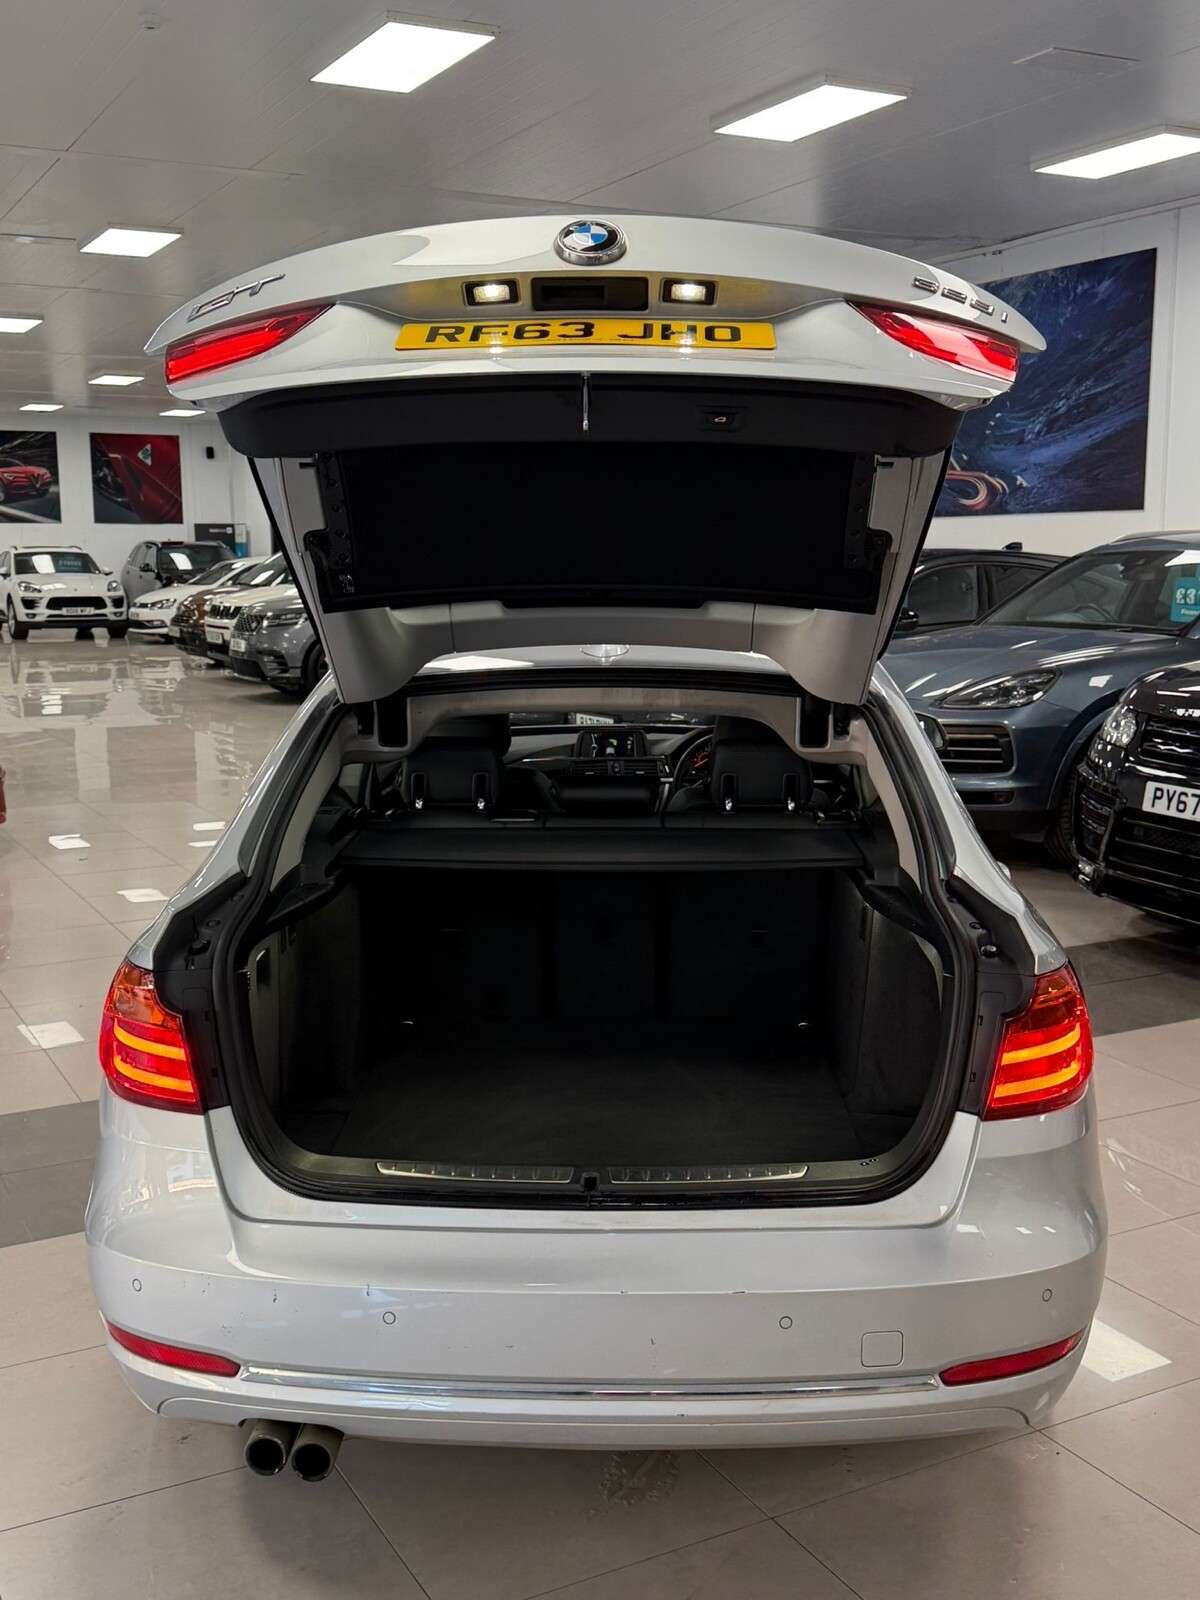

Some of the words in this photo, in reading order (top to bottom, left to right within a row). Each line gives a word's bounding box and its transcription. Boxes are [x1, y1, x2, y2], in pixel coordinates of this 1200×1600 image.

[425, 322, 595, 343] RF63
[618, 323, 742, 343] JHO
[1151, 786, 1200, 816] PY67
